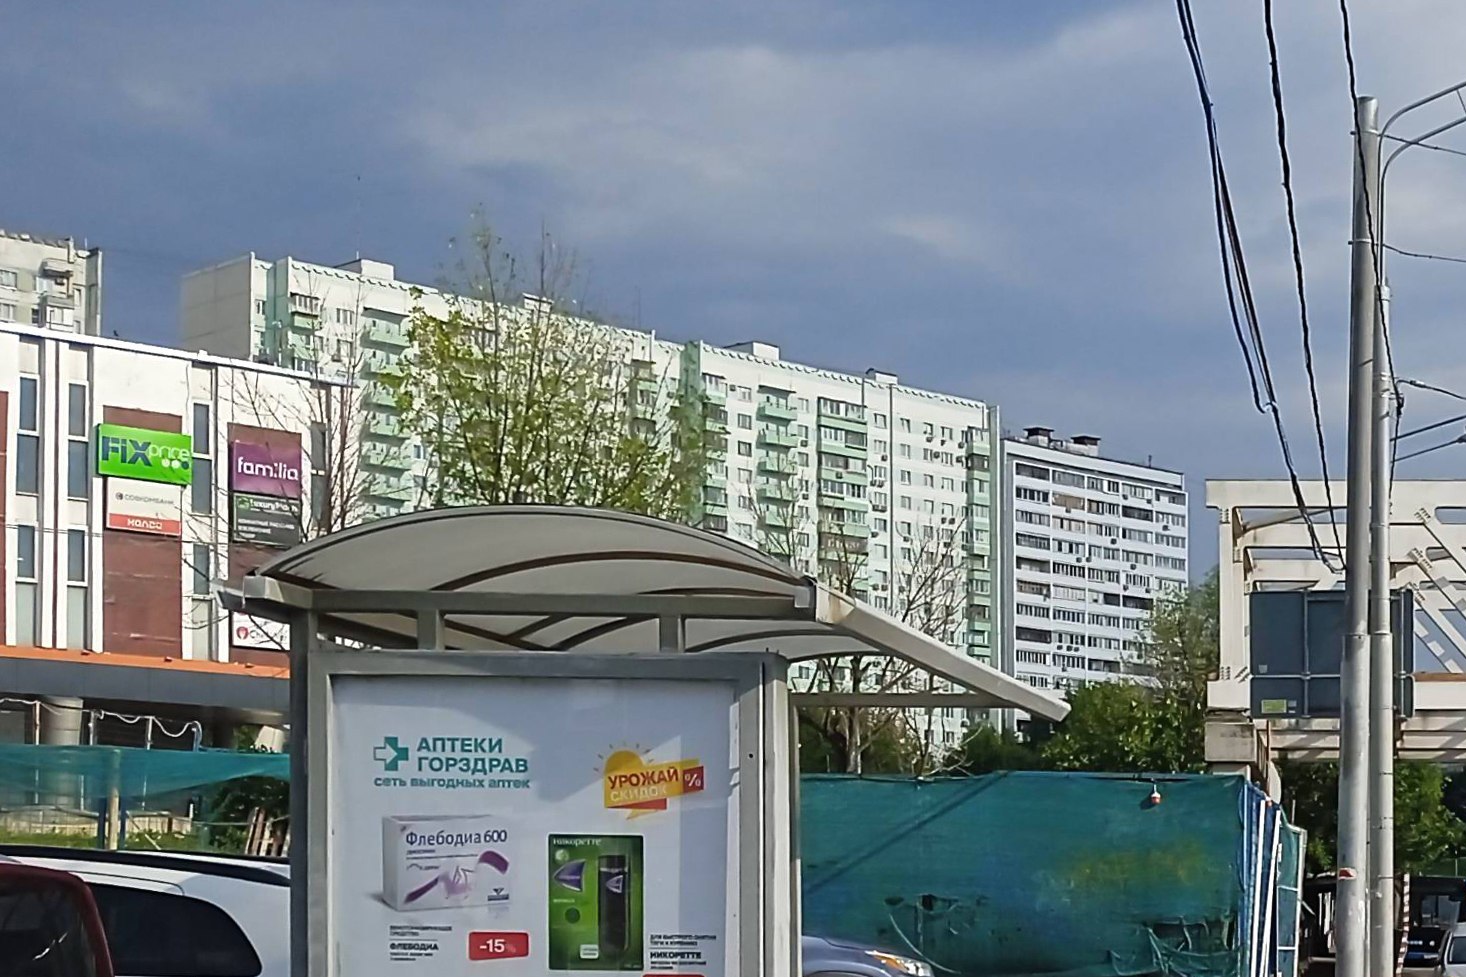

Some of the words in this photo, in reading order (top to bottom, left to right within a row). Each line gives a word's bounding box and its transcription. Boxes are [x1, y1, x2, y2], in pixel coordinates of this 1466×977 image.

[417, 737, 503, 753] АПТЕКИ
[417, 757, 529, 775] ГОРЗДРАВ
[374, 777, 407, 787] сеть
[410, 778, 485, 789] выгодных
[488, 778, 530, 788] аптек
[608, 766, 679, 789] УРОЖАЙ
[406, 830, 481, 847] Флебодиа
[484, 829, 508, 843] 600
[389, 943, 439, 951] ФЛЕБОДИА
[650, 951, 702, 959] НИКОРЕТТЕ
